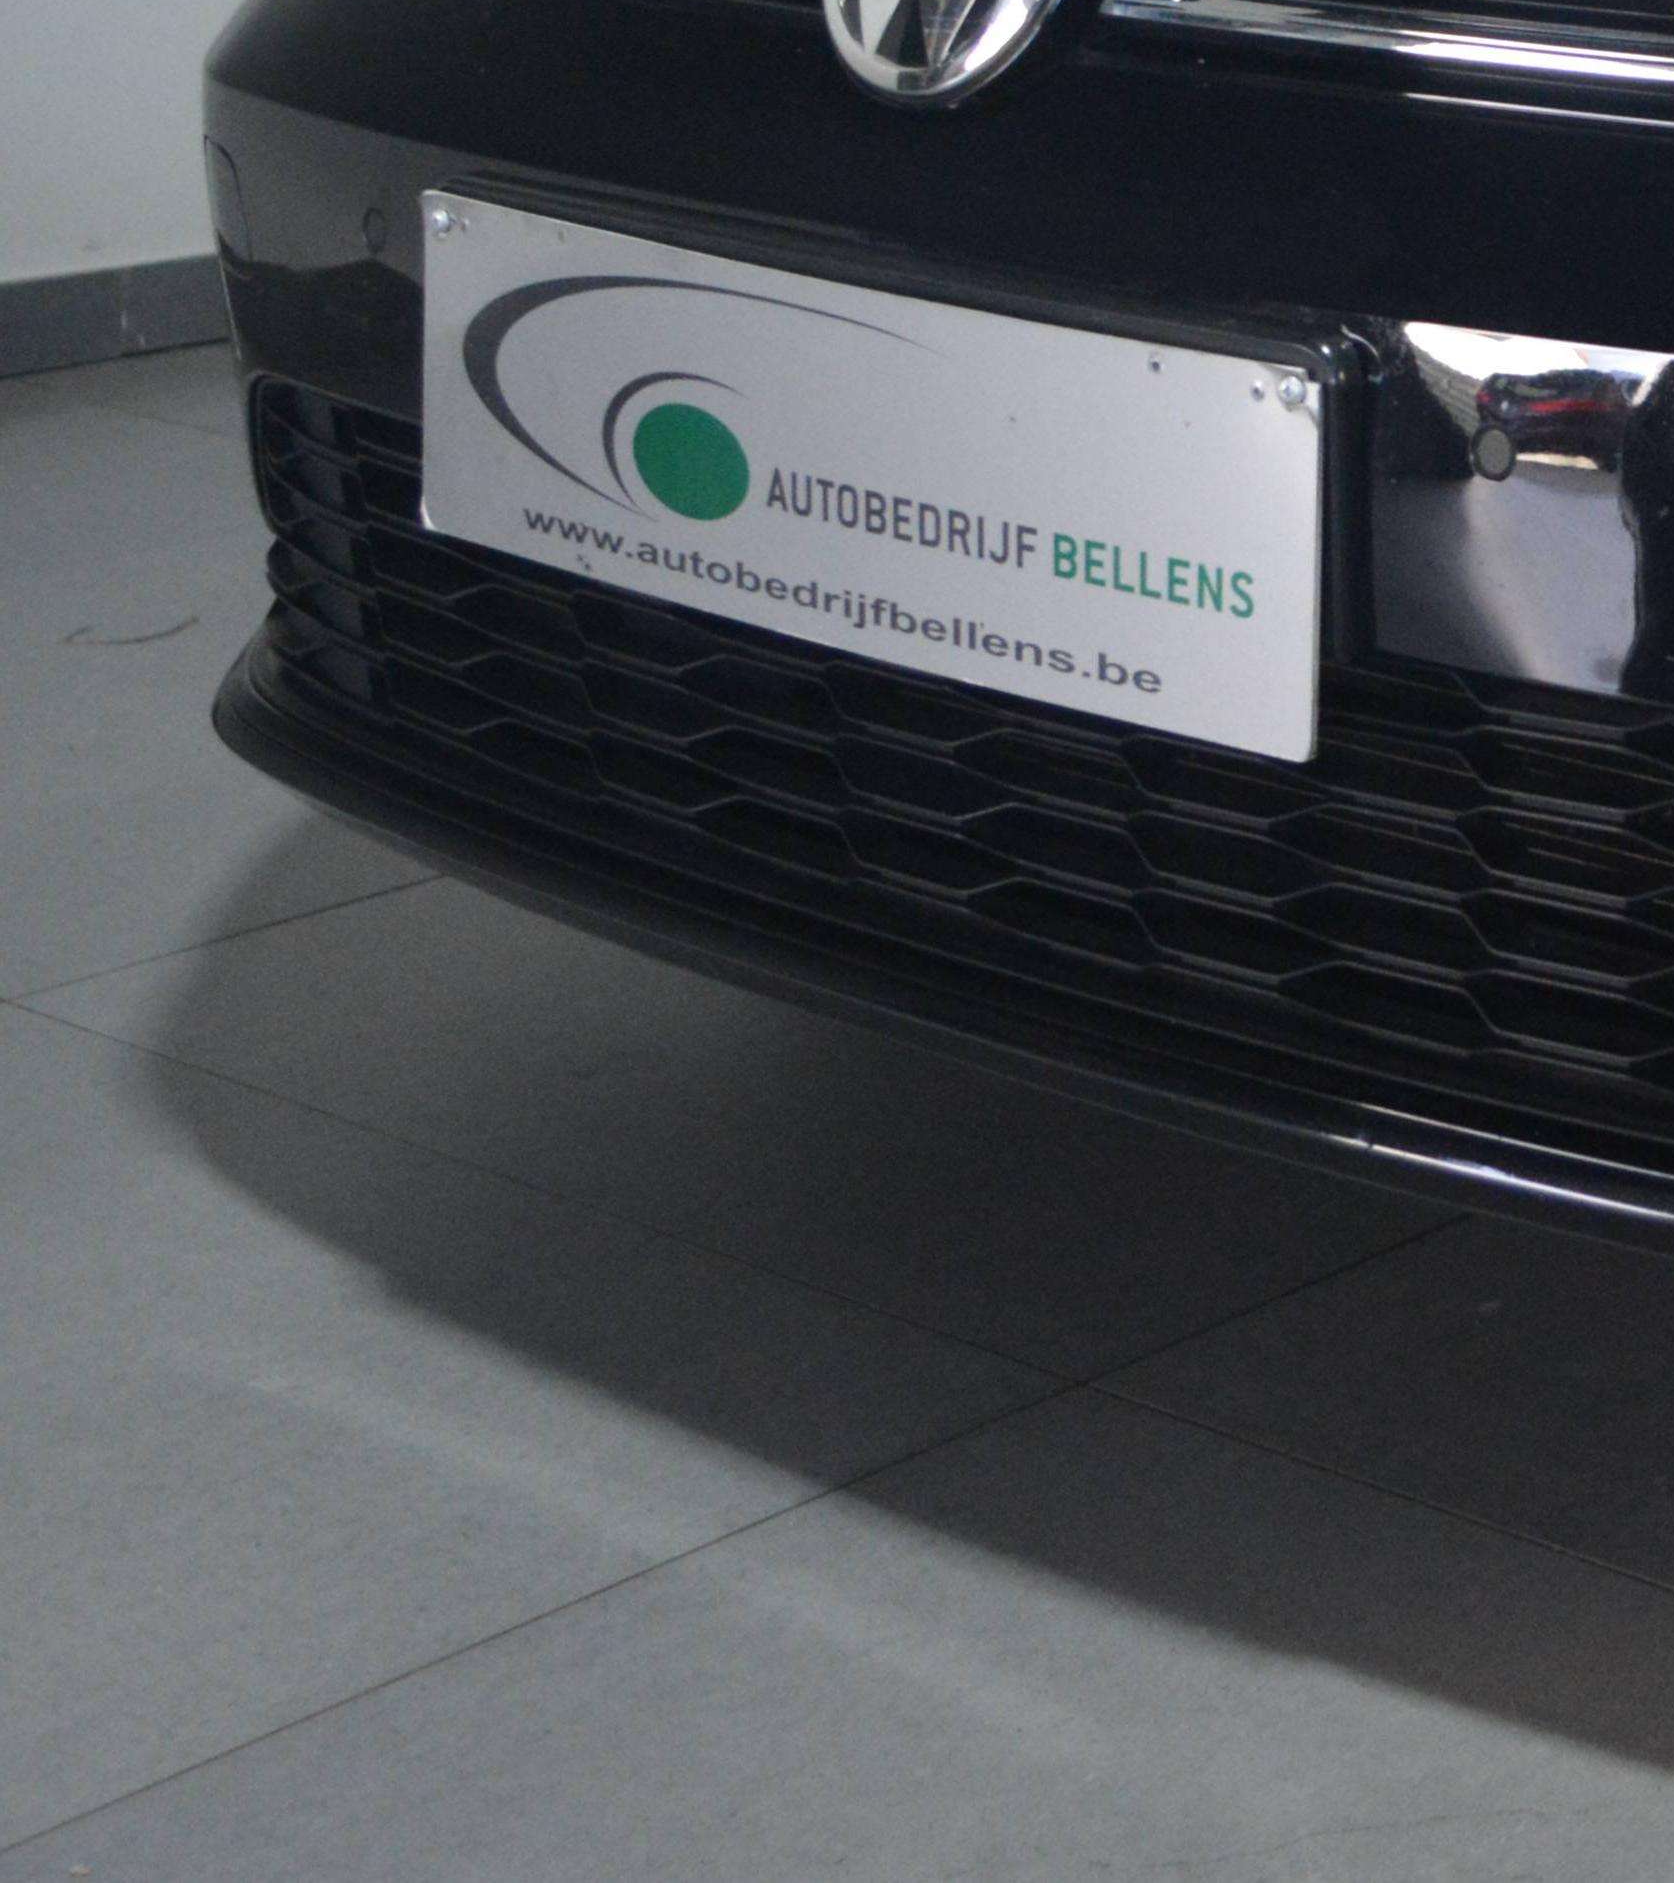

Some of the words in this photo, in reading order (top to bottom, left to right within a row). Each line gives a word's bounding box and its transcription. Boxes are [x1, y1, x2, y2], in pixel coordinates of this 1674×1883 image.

[524, 507, 1162, 695] www.autobedrijfbellens.be
[767, 467, 1037, 571] AUTOBEDRIJF
[1053, 532, 1255, 620] BELLENS
